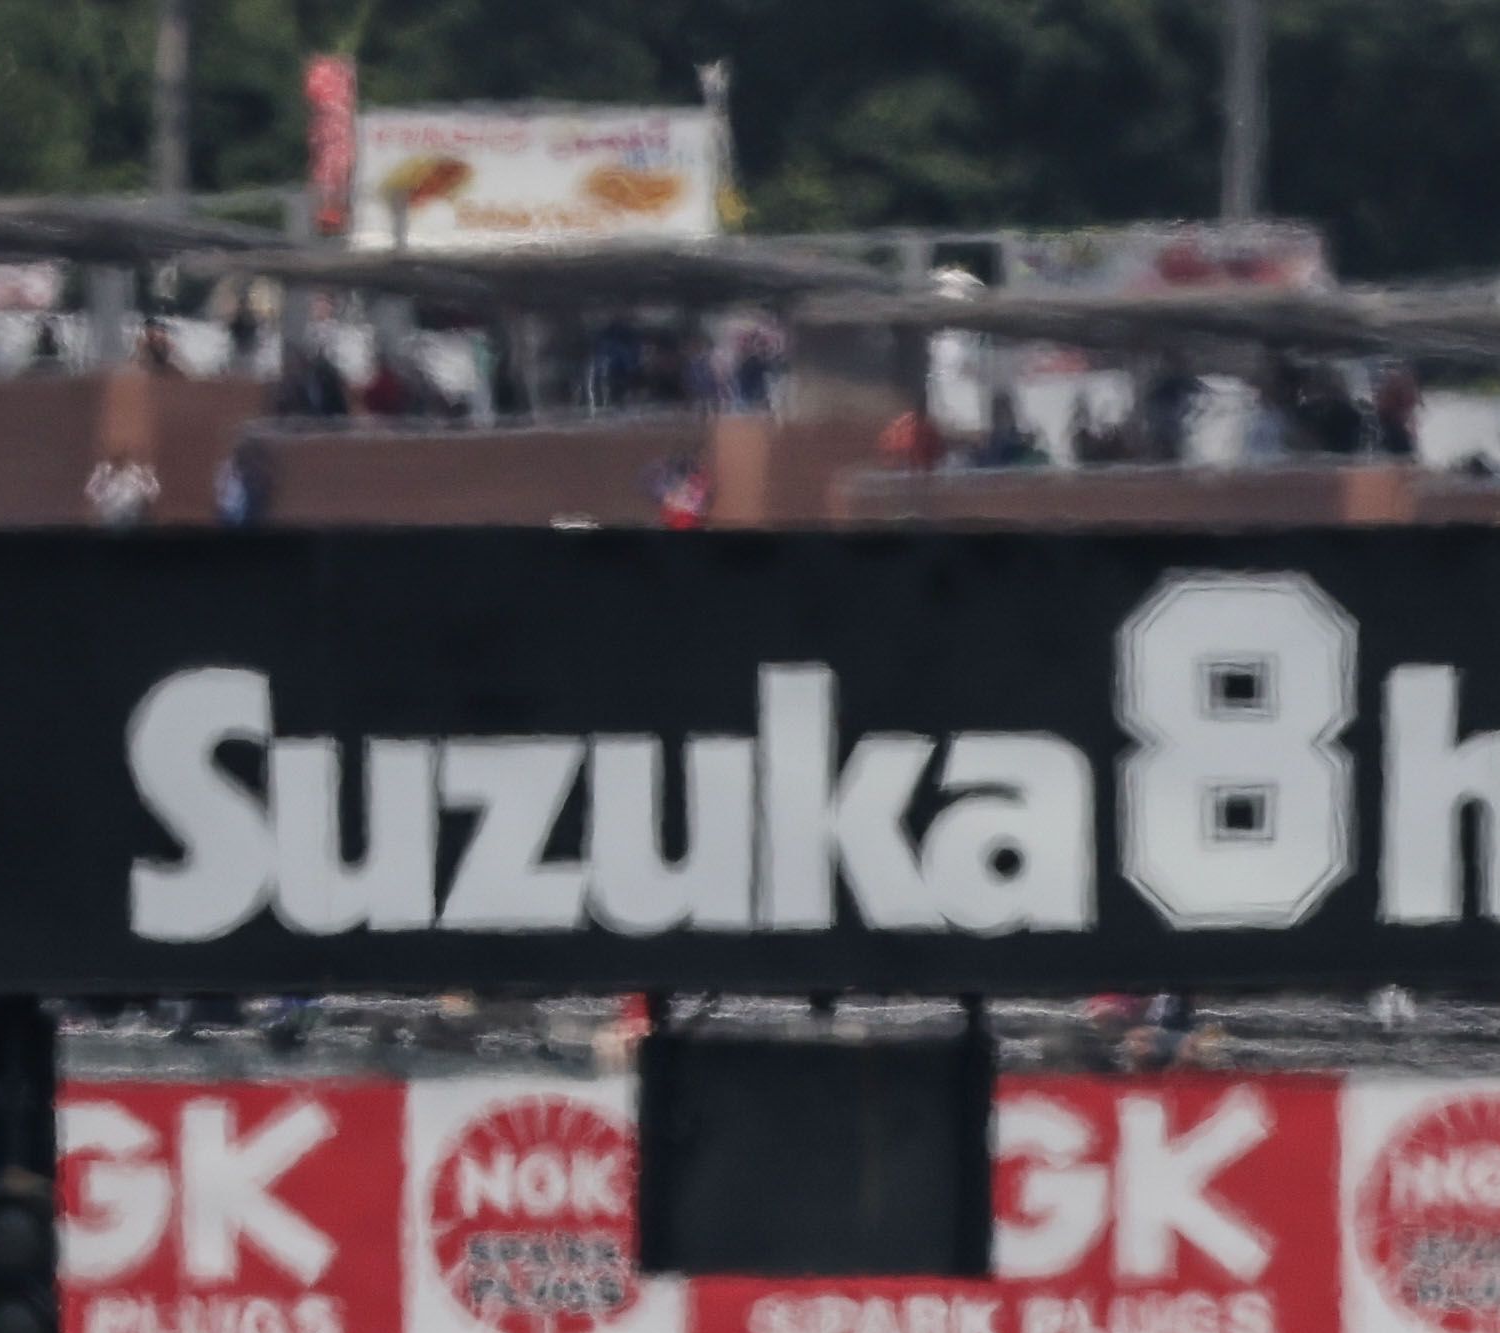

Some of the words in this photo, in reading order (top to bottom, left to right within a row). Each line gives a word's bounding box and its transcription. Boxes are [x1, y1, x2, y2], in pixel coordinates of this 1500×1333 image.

[126, 666, 1100, 940] Suzuka
[1118, 570, 1360, 932] 8
[56, 1100, 338, 1286] GK
[992, 1086, 1274, 1284] GK
